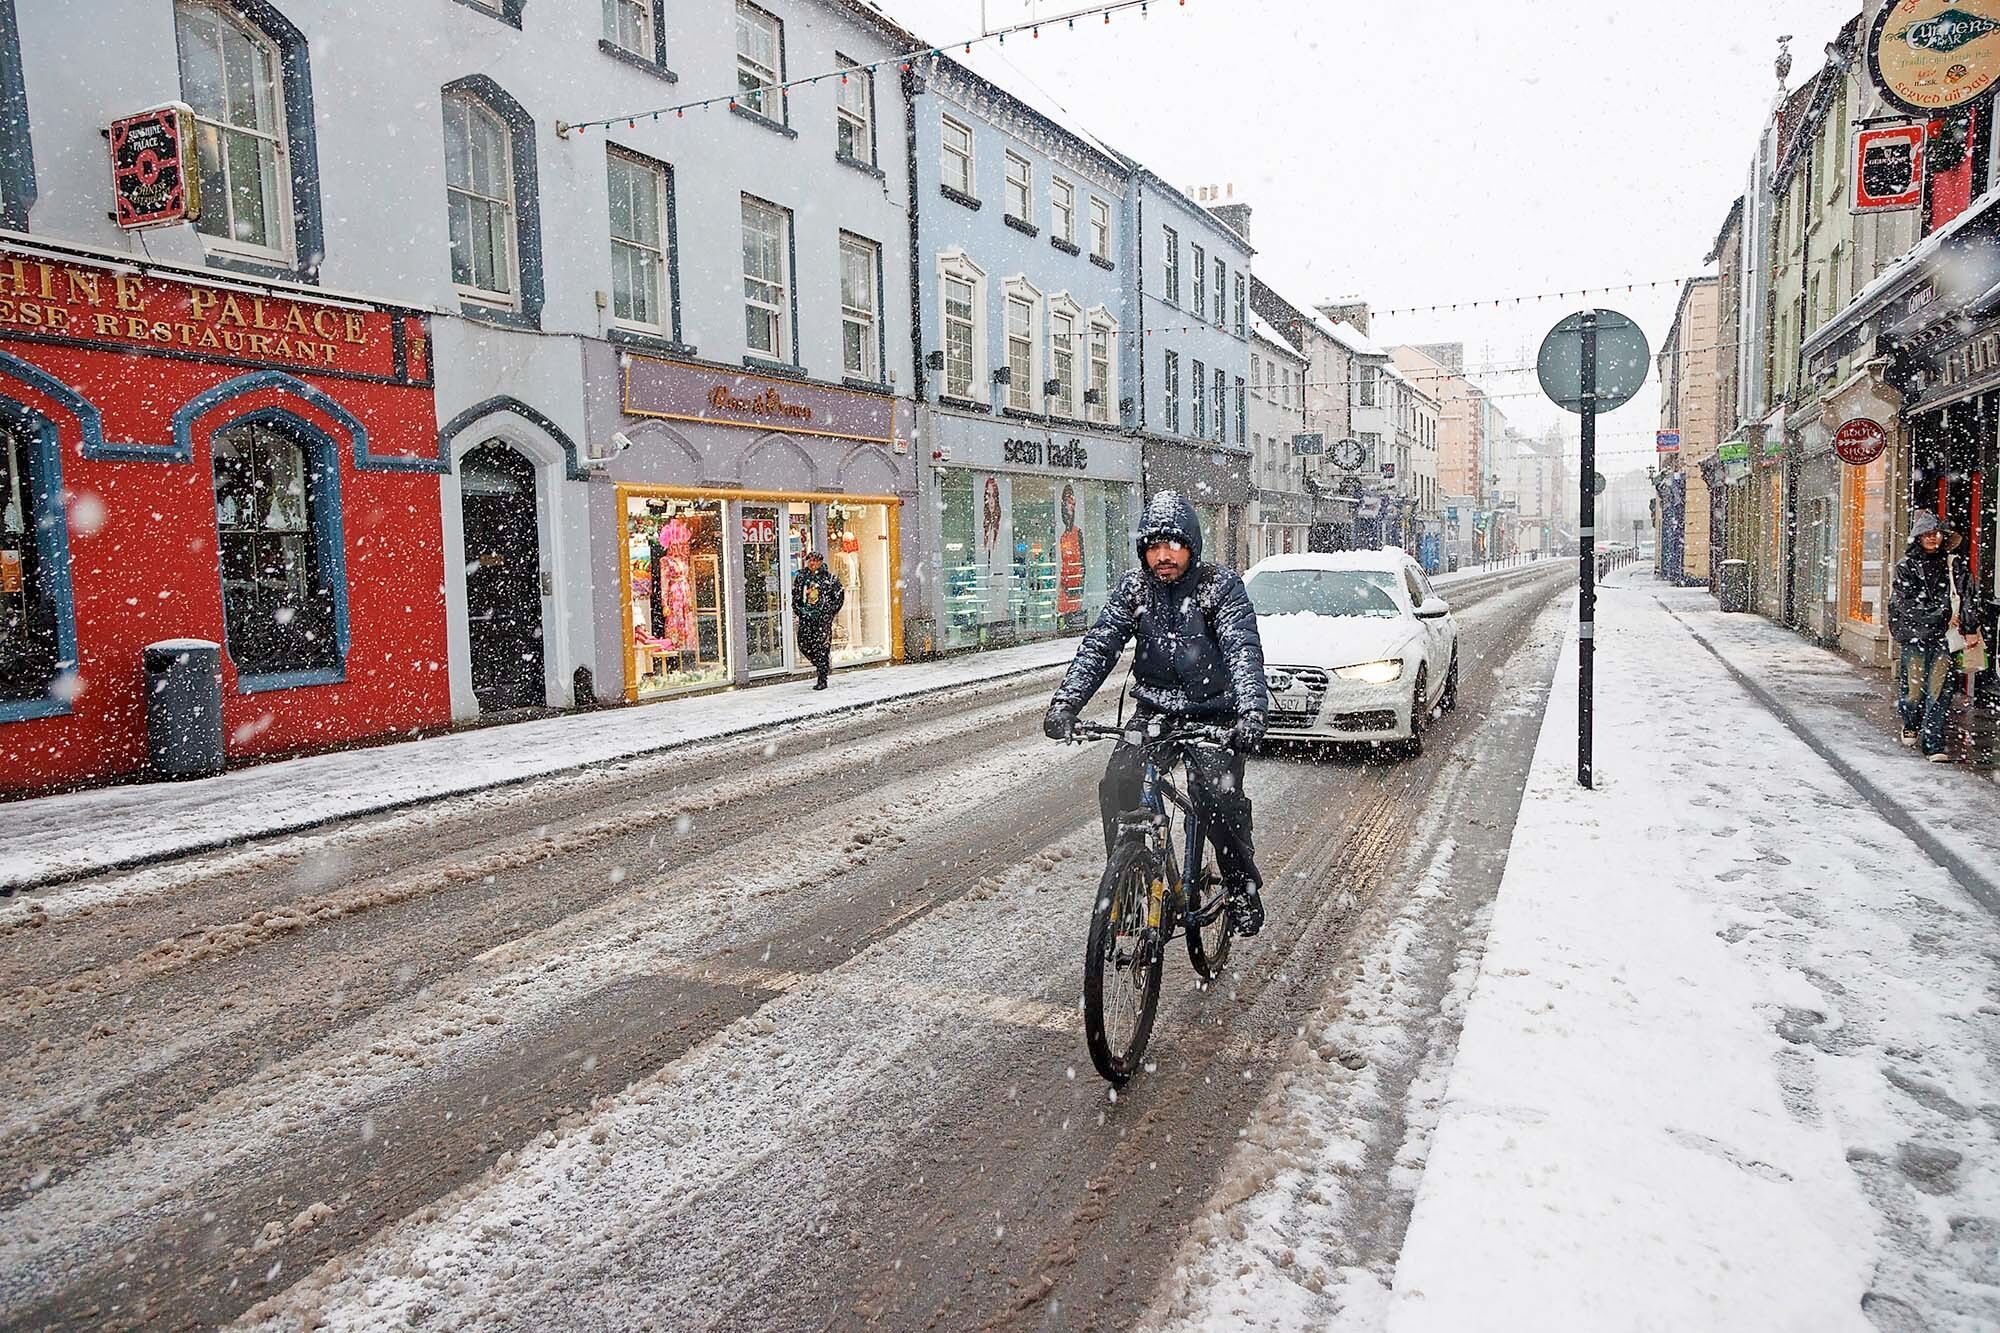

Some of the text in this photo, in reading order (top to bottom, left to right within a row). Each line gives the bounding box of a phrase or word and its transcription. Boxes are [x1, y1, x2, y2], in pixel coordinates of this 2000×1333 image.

[133, 137, 158, 150] PALACE
[186, 286, 368, 345] PALACE
[93, 313, 338, 364] RESTAURANT
[1004, 437, 1042, 465] sean
[742, 521, 773, 543] sale
